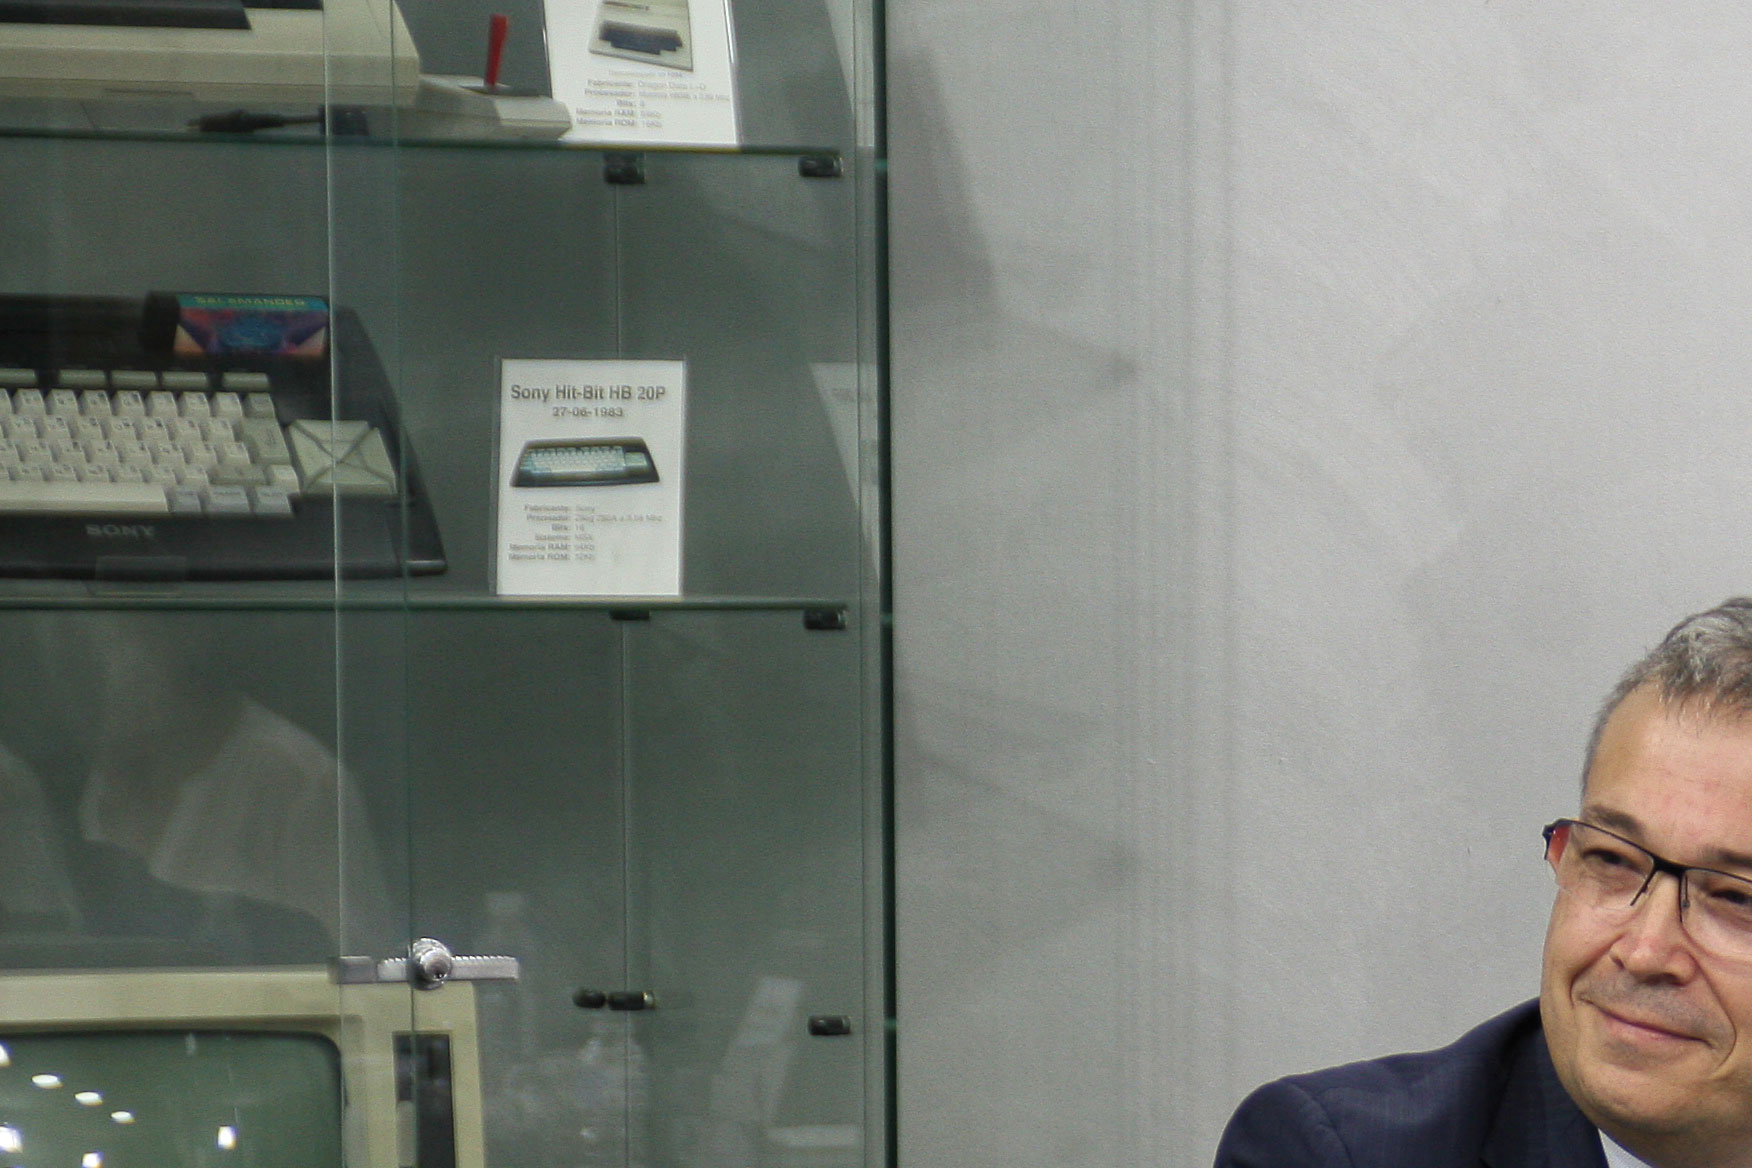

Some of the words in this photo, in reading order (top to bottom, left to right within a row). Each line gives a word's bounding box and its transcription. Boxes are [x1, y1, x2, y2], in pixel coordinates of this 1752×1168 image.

[511, 384, 550, 403] Sony
[555, 384, 604, 400] Hit-Bit
[609, 385, 632, 400] HB
[637, 386, 666, 401] 20P
[86, 525, 154, 538] SONY
